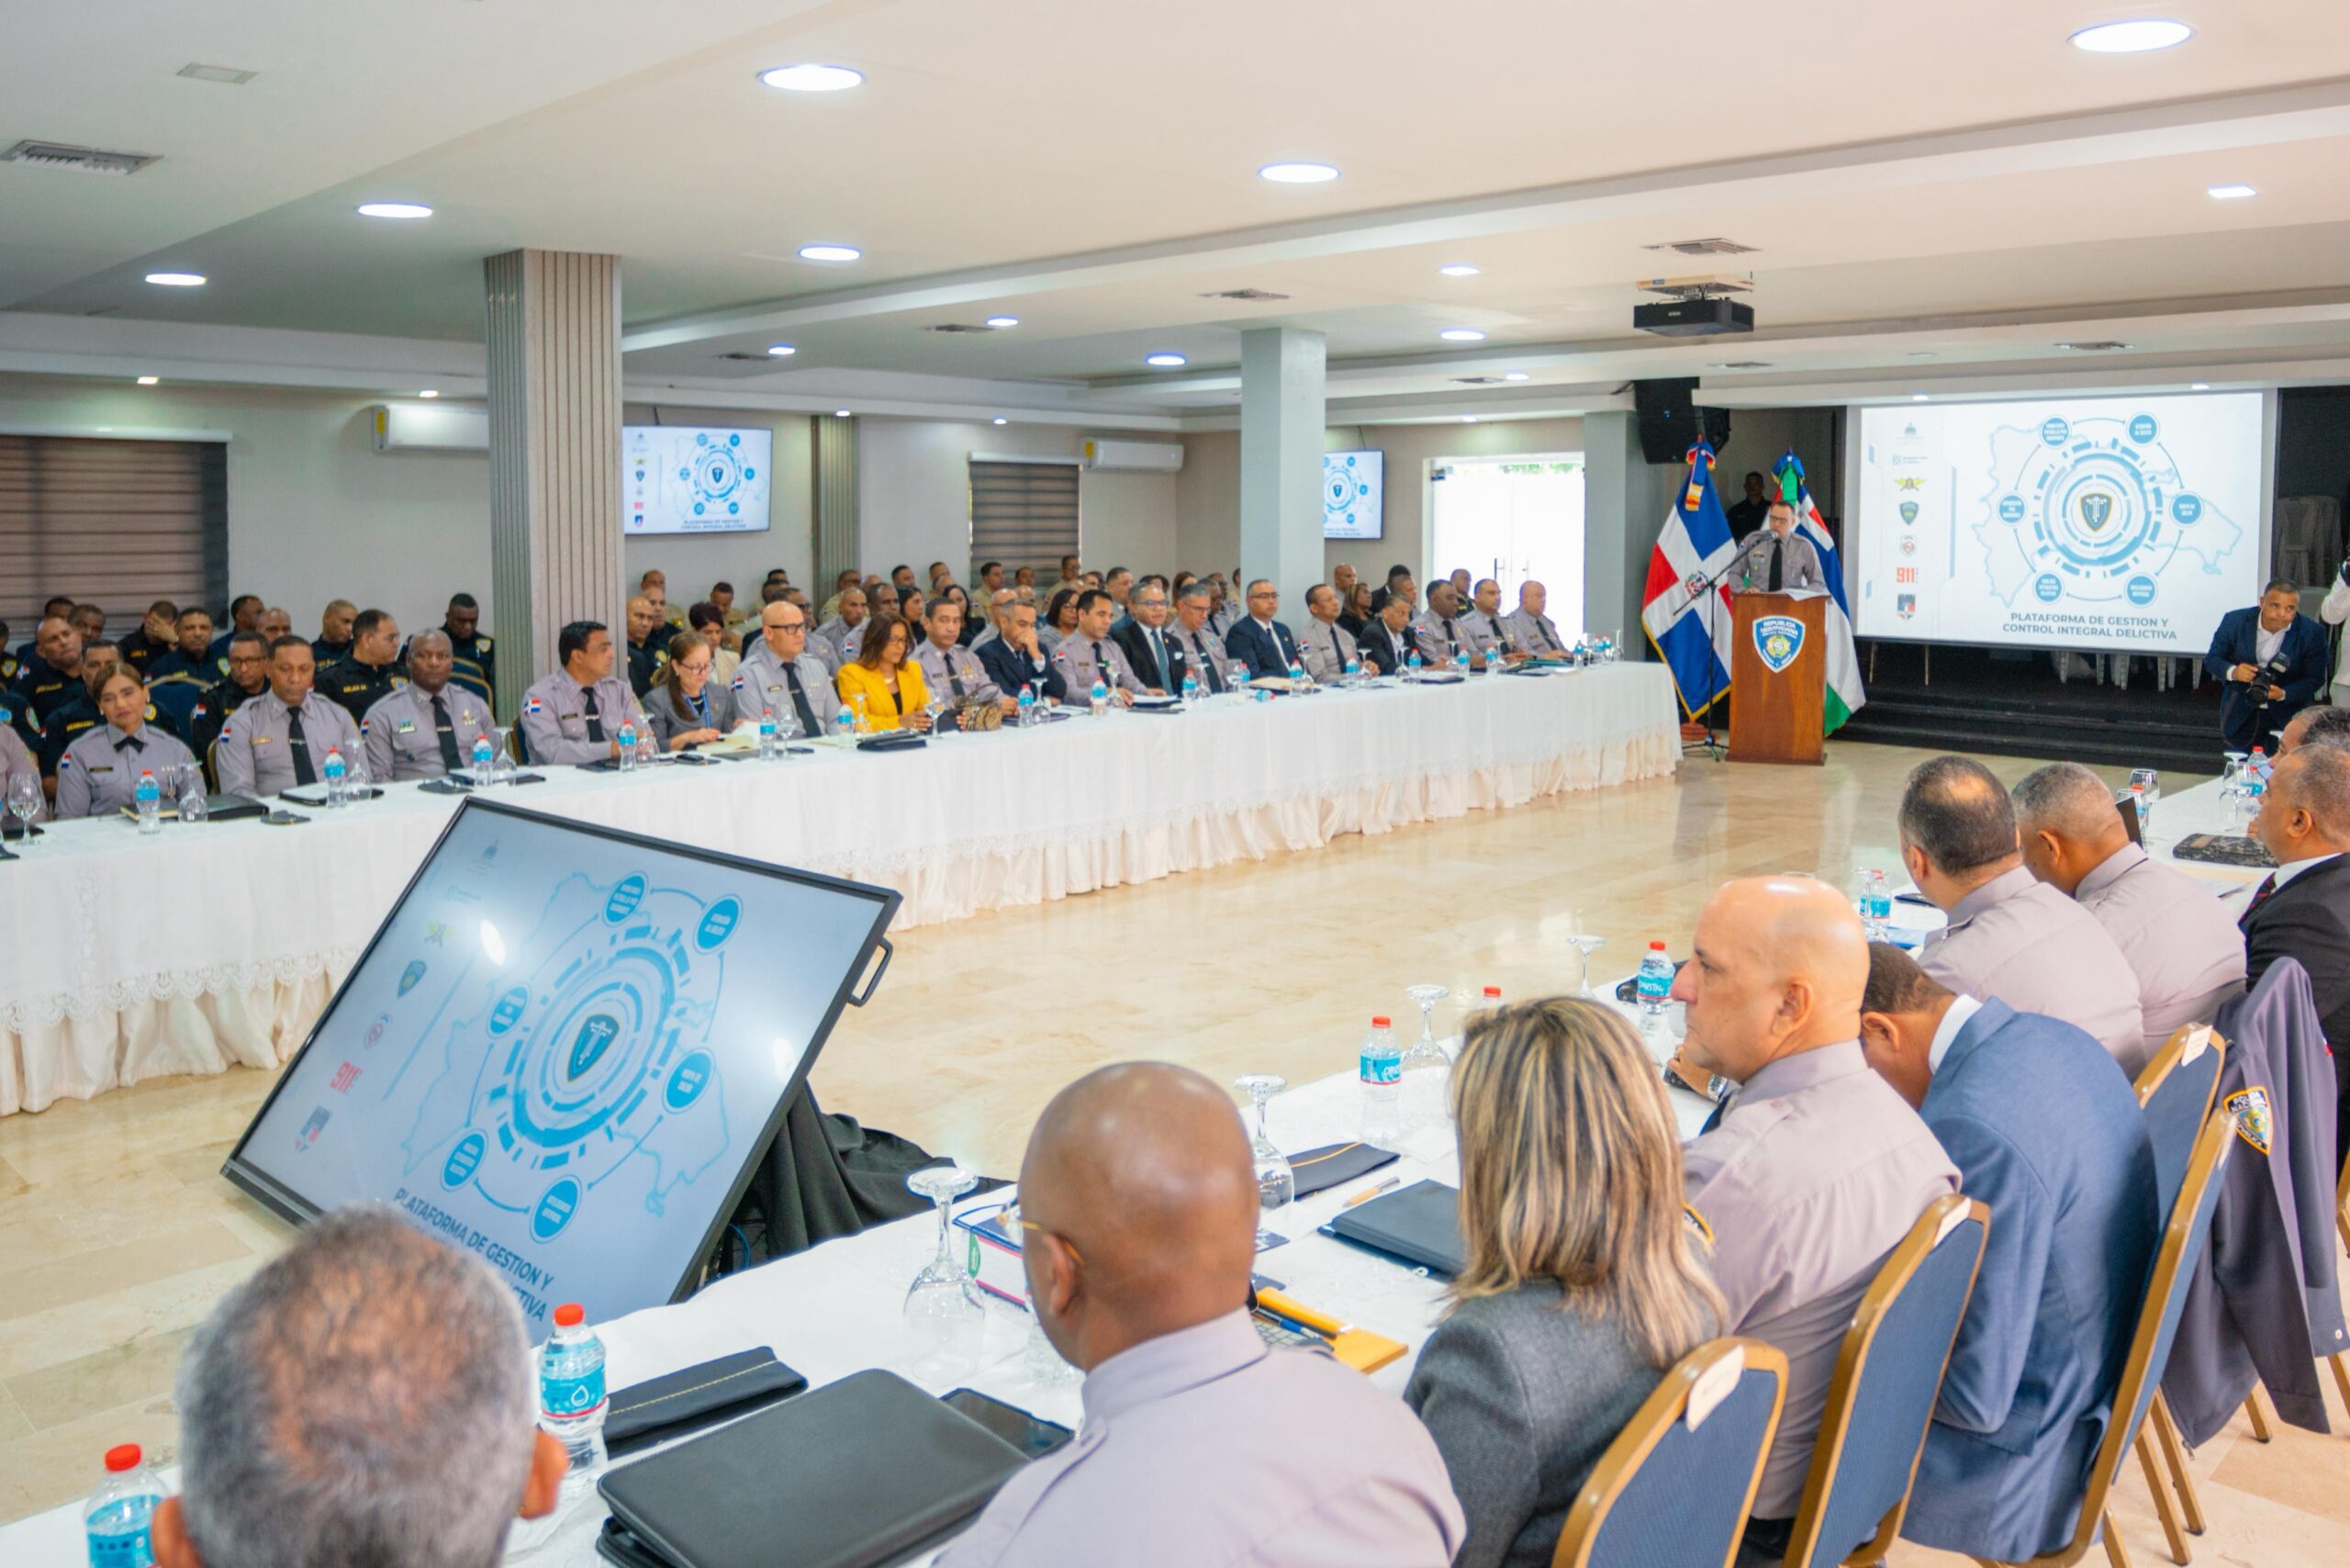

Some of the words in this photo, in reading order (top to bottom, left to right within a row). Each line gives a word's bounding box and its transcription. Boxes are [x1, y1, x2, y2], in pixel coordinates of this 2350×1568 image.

[1896, 566, 1915, 583] 911
[2010, 612, 2086, 623] PLATAFORMA
[2088, 615, 2104, 625] DE
[2108, 616, 2158, 627] GESTION
[2161, 618, 2168, 627] Y
[2003, 623, 2053, 634] CONTROL
[2057, 626, 2112, 637] INTEGRAL
[2116, 629, 2177, 640] DELICTIVA
[393, 1188, 468, 1242] PLATAFORMA
[466, 1231, 488, 1253] DE
[486, 1243, 543, 1286] GESTION
[540, 1272, 554, 1292] Y
